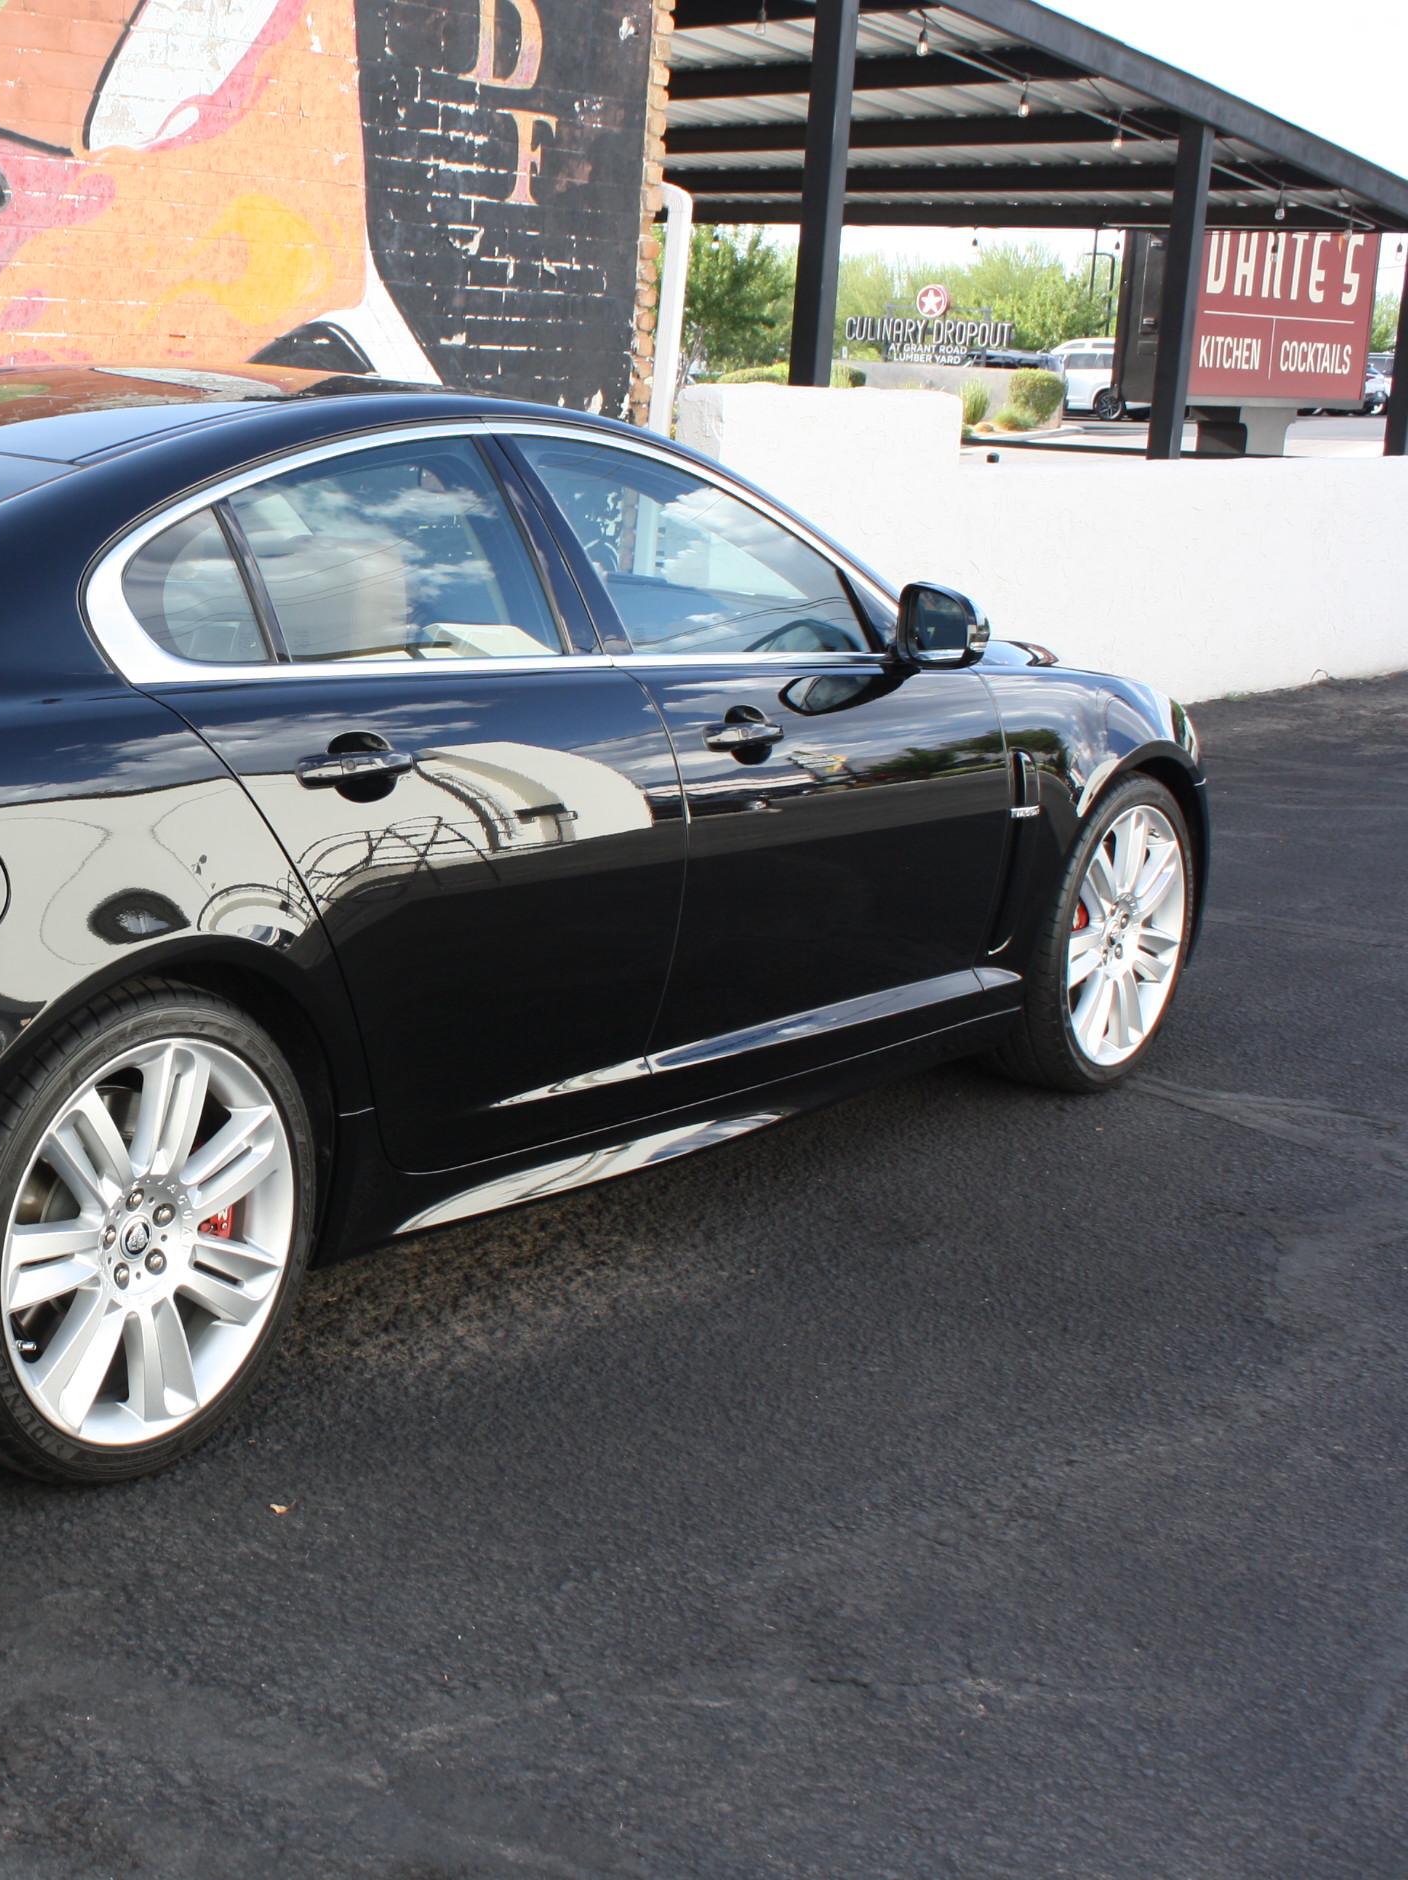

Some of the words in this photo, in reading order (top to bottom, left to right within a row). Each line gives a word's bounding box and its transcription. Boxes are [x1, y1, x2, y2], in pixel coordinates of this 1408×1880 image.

[457, 0, 543, 90] D
[496, 109, 559, 206] F
[845, 317, 928, 343] CULINARY
[933, 319, 1014, 347] DROPOUT
[889, 342, 902, 351] AT
[903, 343, 936, 354] GRANT
[939, 344, 968, 355] ROAD
[893, 353, 933, 364] LUMBER
[934, 355, 961, 365] YARD
[1199, 335, 1261, 370] KITCHEN
[1280, 340, 1352, 375] COCKTAILS
